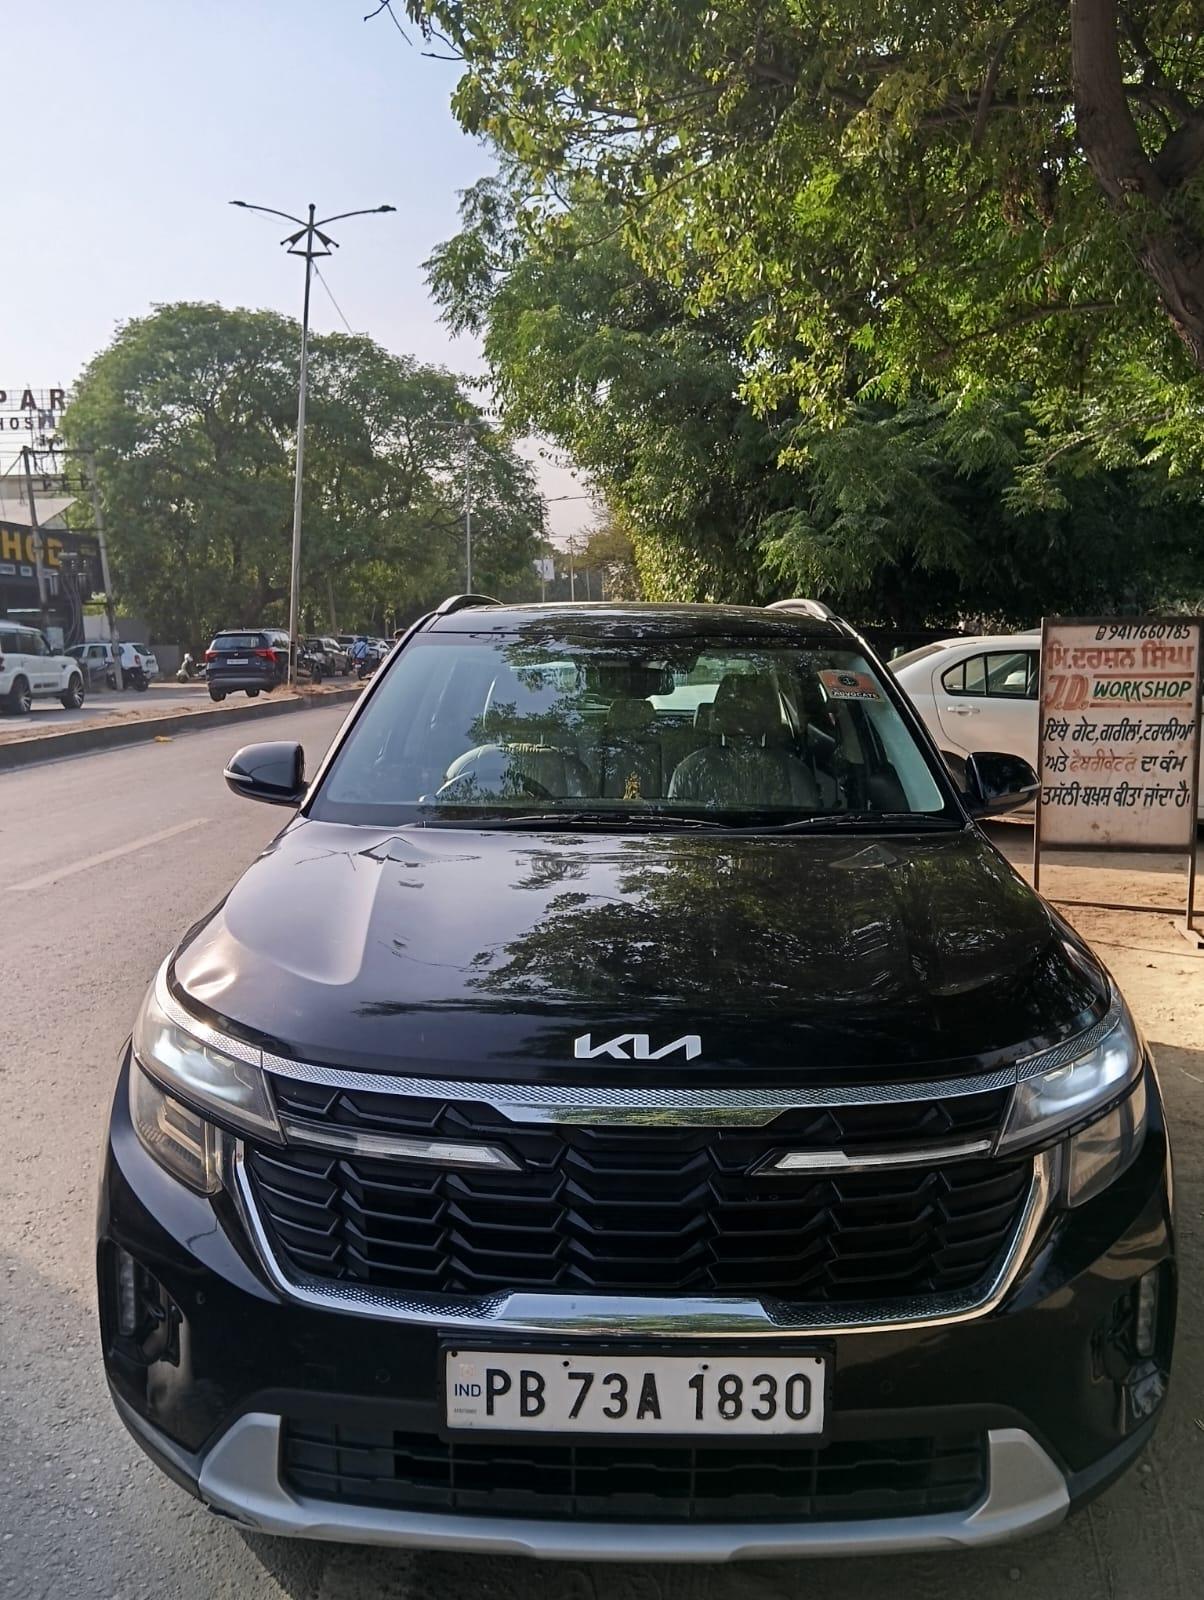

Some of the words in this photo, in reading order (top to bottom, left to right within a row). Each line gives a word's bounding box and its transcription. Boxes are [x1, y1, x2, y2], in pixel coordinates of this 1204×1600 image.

[1108, 625, 1191, 640] 9417660785
[1141, 639, 1195, 670] ਸਿੰਘ
[1093, 681, 1192, 702] WORKSHOP
[1044, 747, 1069, 773] ਅਤੇ
[1141, 755, 1159, 772] ਦਾ
[1159, 750, 1188, 773] ਕੰਮ
[1113, 781, 1143, 807] ਕੀਤਾ
[1143, 783, 1174, 807] ਜਾਂਦਾ
[574, 1033, 702, 1061] KIA
[454, 1383, 482, 1398] IND
[484, 1368, 546, 1418] PB
[568, 1372, 662, 1420] 73A
[688, 1372, 813, 1421] 1830
